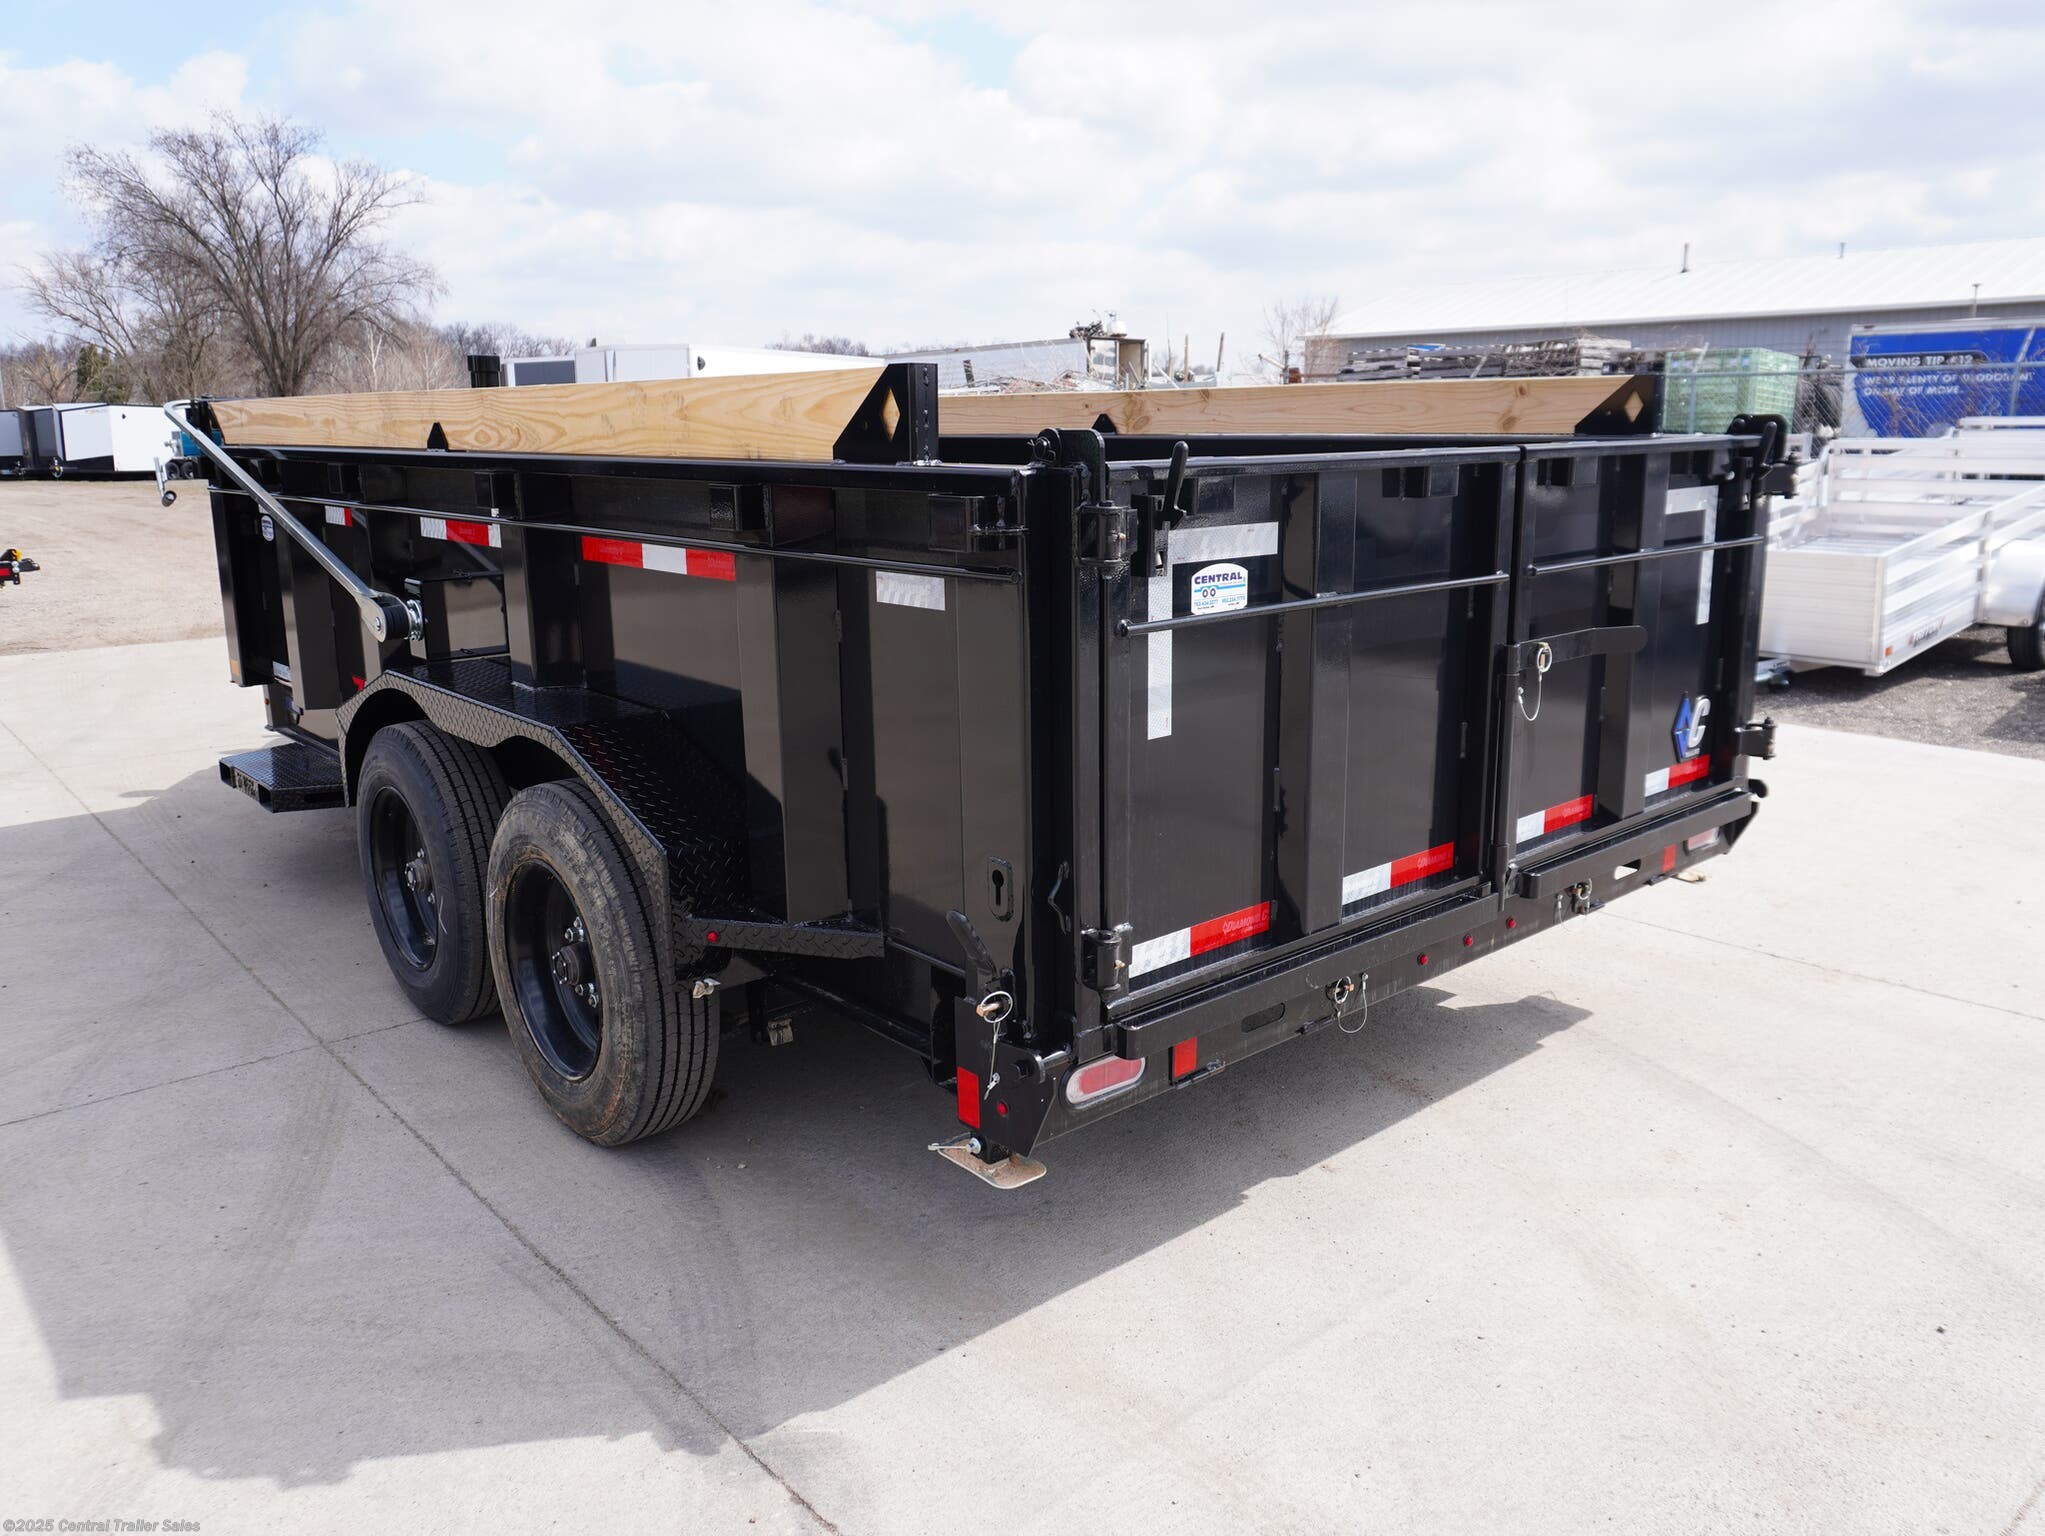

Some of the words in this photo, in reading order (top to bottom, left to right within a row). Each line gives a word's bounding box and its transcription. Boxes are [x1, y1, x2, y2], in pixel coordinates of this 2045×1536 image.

[1866, 356, 1920, 368] MOVING
[1926, 355, 1944, 366] TIP
[1194, 572, 1242, 584] CENTRAL
